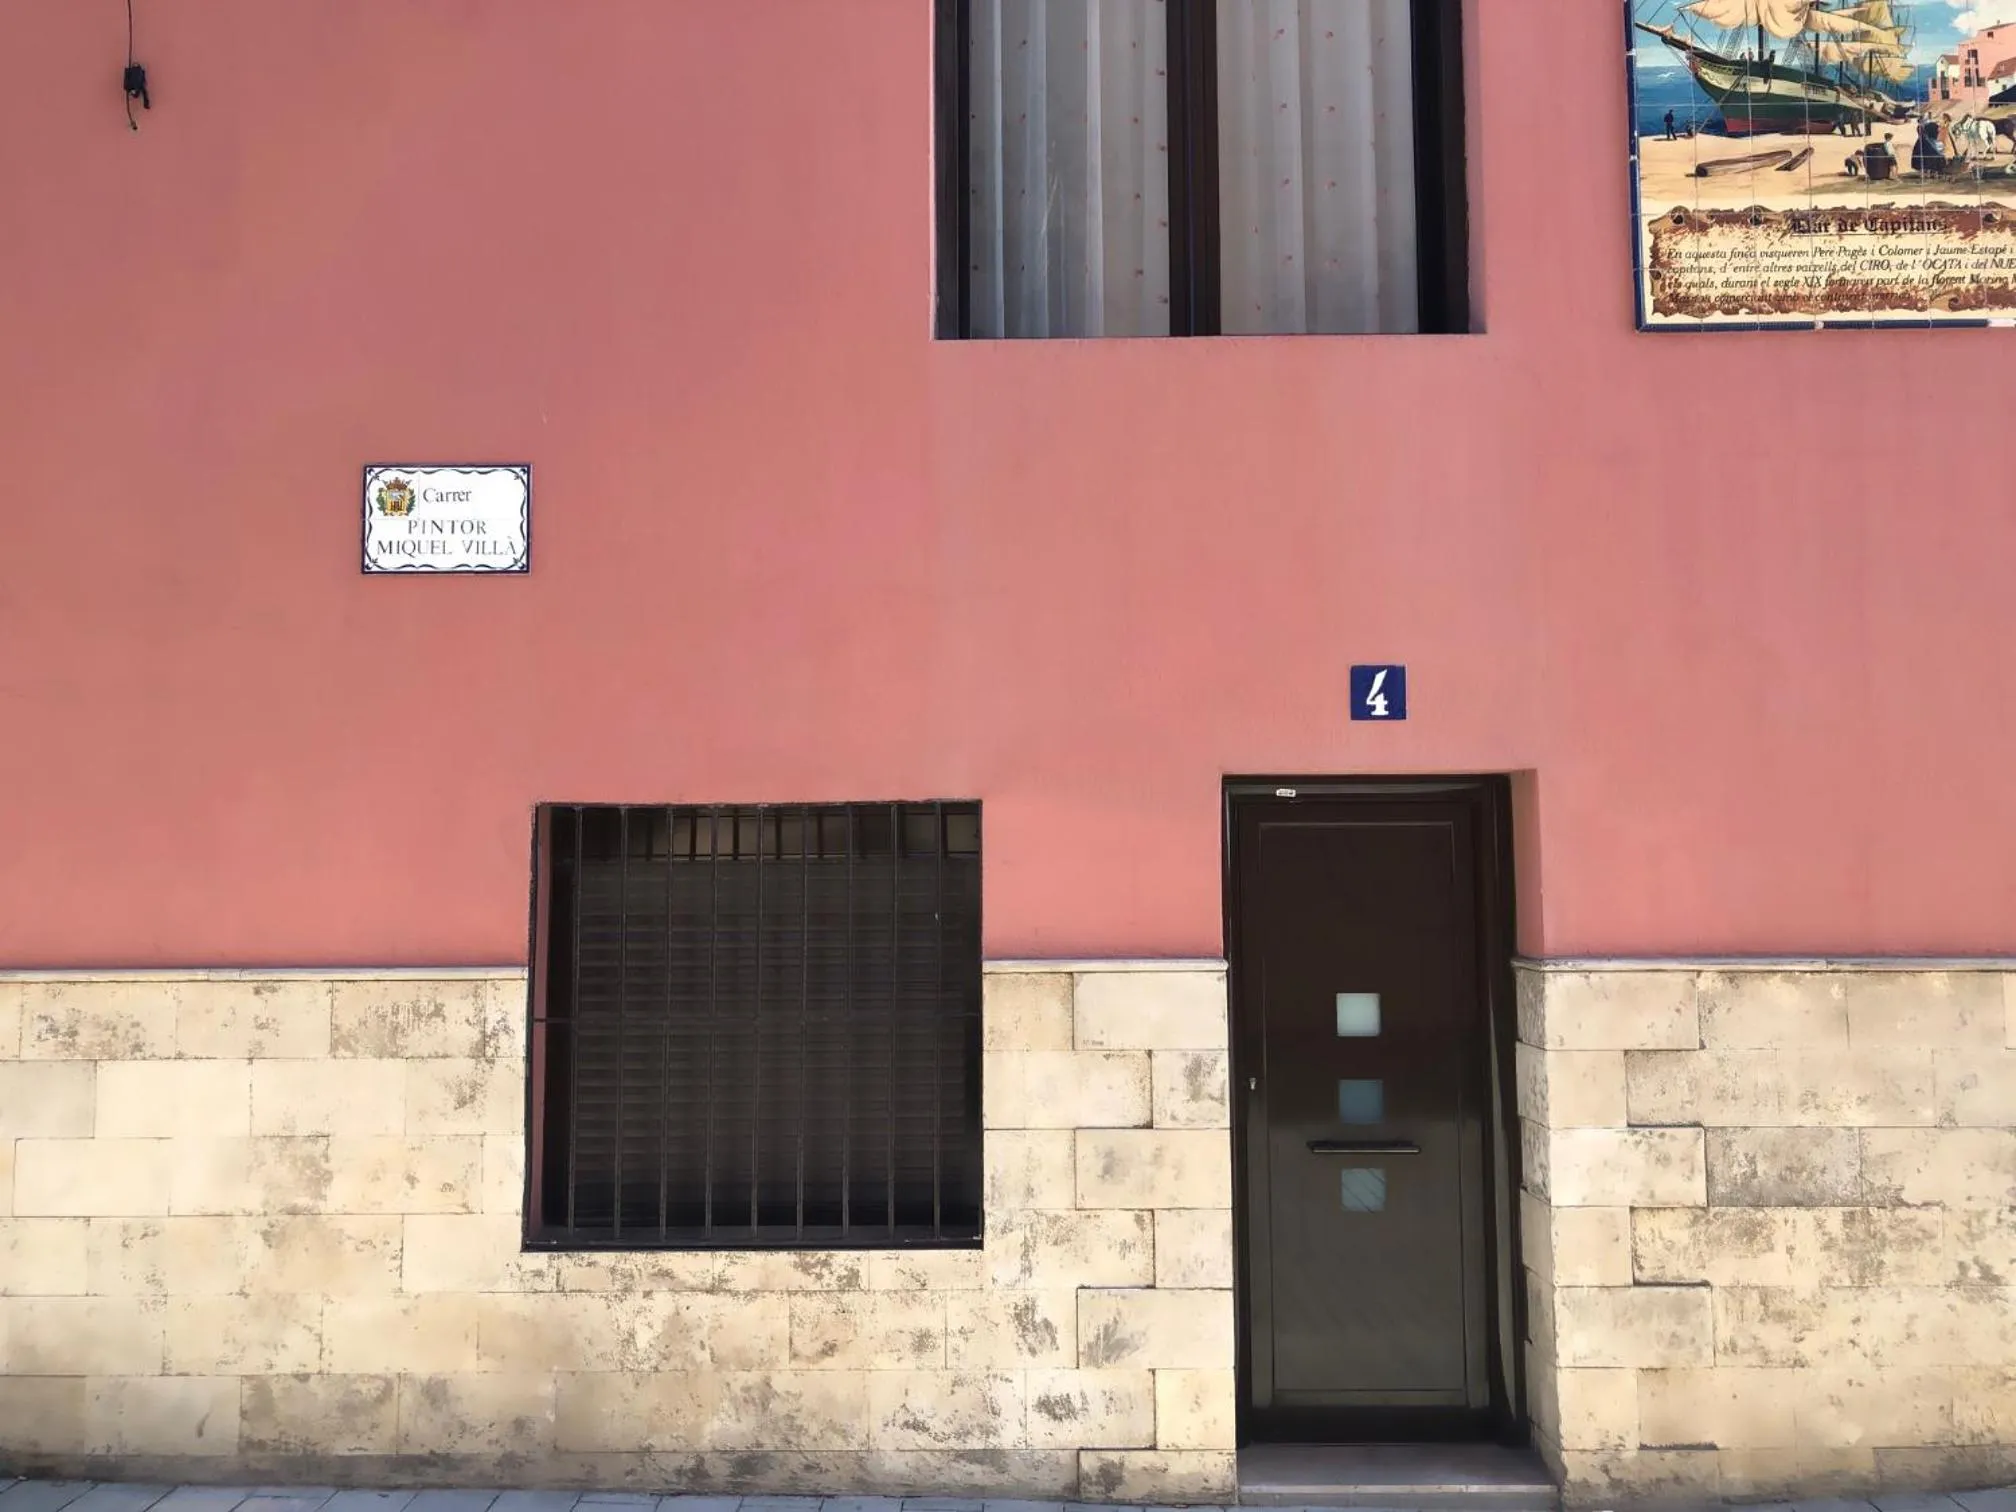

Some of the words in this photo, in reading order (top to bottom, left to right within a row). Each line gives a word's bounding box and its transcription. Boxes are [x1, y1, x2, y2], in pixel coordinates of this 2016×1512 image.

[1667, 248, 1683, 259] En
[1685, 249, 1727, 262] aquesta
[1728, 246, 1757, 262] finca
[1760, 248, 1809, 261] visqueren
[1813, 245, 1835, 257] Pere
[1878, 244, 1924, 256] Colomer
[1934, 244, 1967, 255] Jaume
[1971, 243, 2008, 258] Estapé
[1763, 261, 1793, 273] altres
[1840, 259, 1857, 272] del
[1896, 258, 1909, 271] de
[1971, 258, 1988, 270] del
[1685, 277, 1718, 290] quals,
[1720, 276, 1758, 288] durant
[1761, 276, 1771, 287] el
[1774, 275, 1799, 291] segle
[1804, 275, 1822, 288] XIX
[1902, 273, 1914, 285] de
[1918, 273, 1929, 285] la
[422, 487, 472, 503] Carrer
[408, 519, 487, 535] PINTOR
[377, 539, 452, 558] MIQUEL
[462, 536, 516, 556] VILLÀ
[1366, 668, 1389, 716] 4
